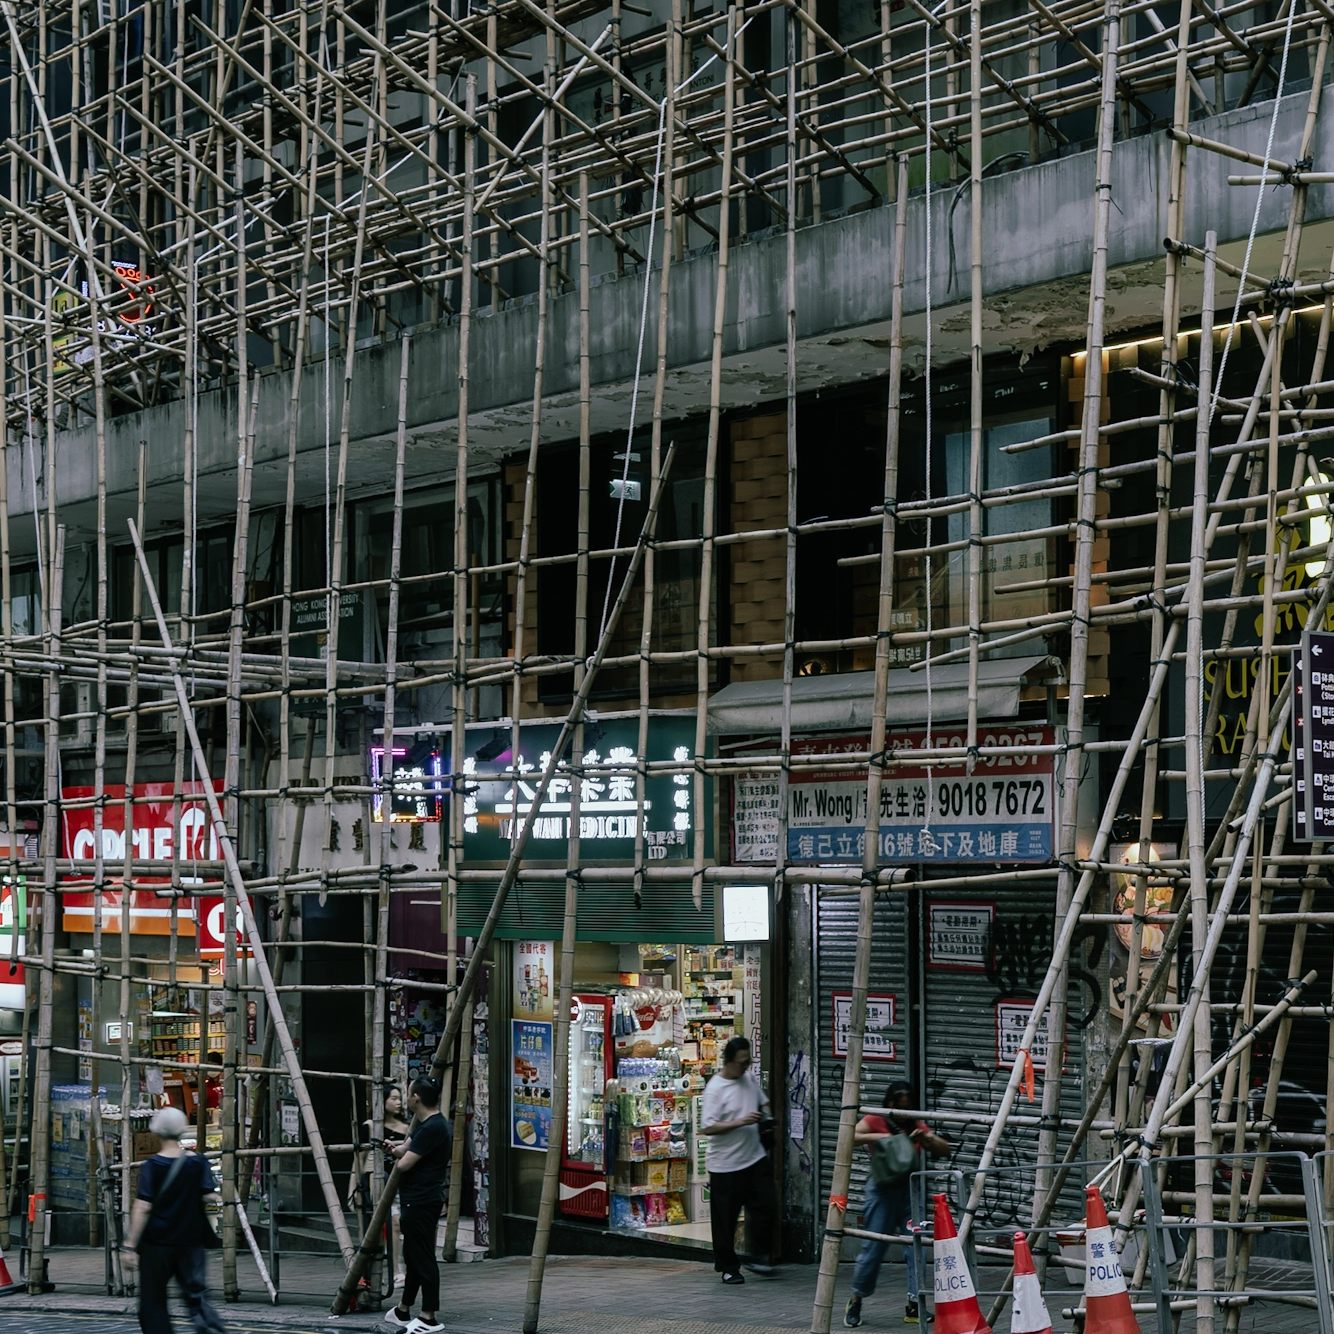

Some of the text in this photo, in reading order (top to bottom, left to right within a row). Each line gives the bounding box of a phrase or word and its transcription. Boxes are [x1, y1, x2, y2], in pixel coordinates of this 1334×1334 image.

[793, 789, 812, 818] Mr.
[814, 788, 853, 823] Wong
[939, 781, 986, 817] 9018
[992, 779, 1045, 816] 7672
[647, 845, 668, 860] LTD
[1090, 1264, 1123, 1282] POLIC
[934, 1274, 968, 1292] OLICE
